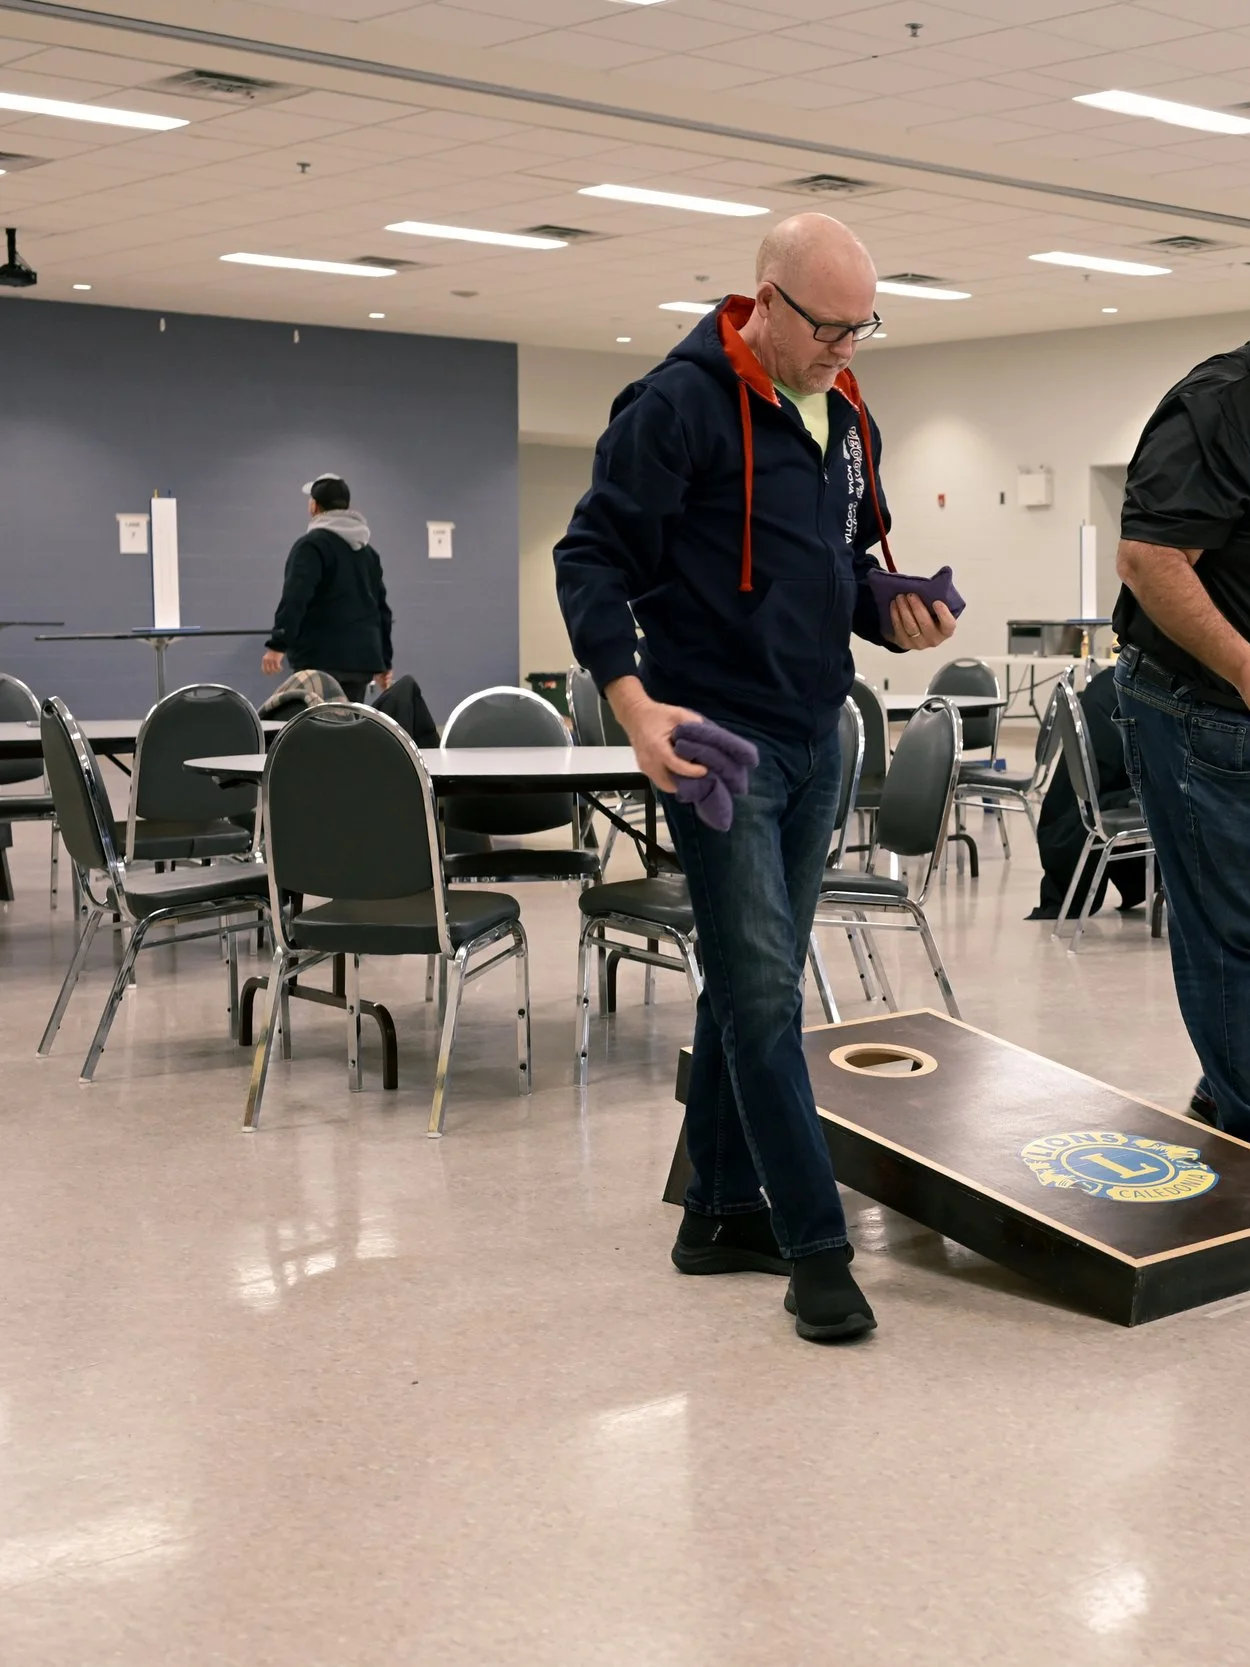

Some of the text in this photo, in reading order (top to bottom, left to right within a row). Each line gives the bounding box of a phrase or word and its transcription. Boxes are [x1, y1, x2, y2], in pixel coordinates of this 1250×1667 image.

[1027, 1133, 1119, 1160] LIONS
[1080, 1153, 1160, 1179] L
[1119, 1173, 1208, 1199] CALEDONIA
